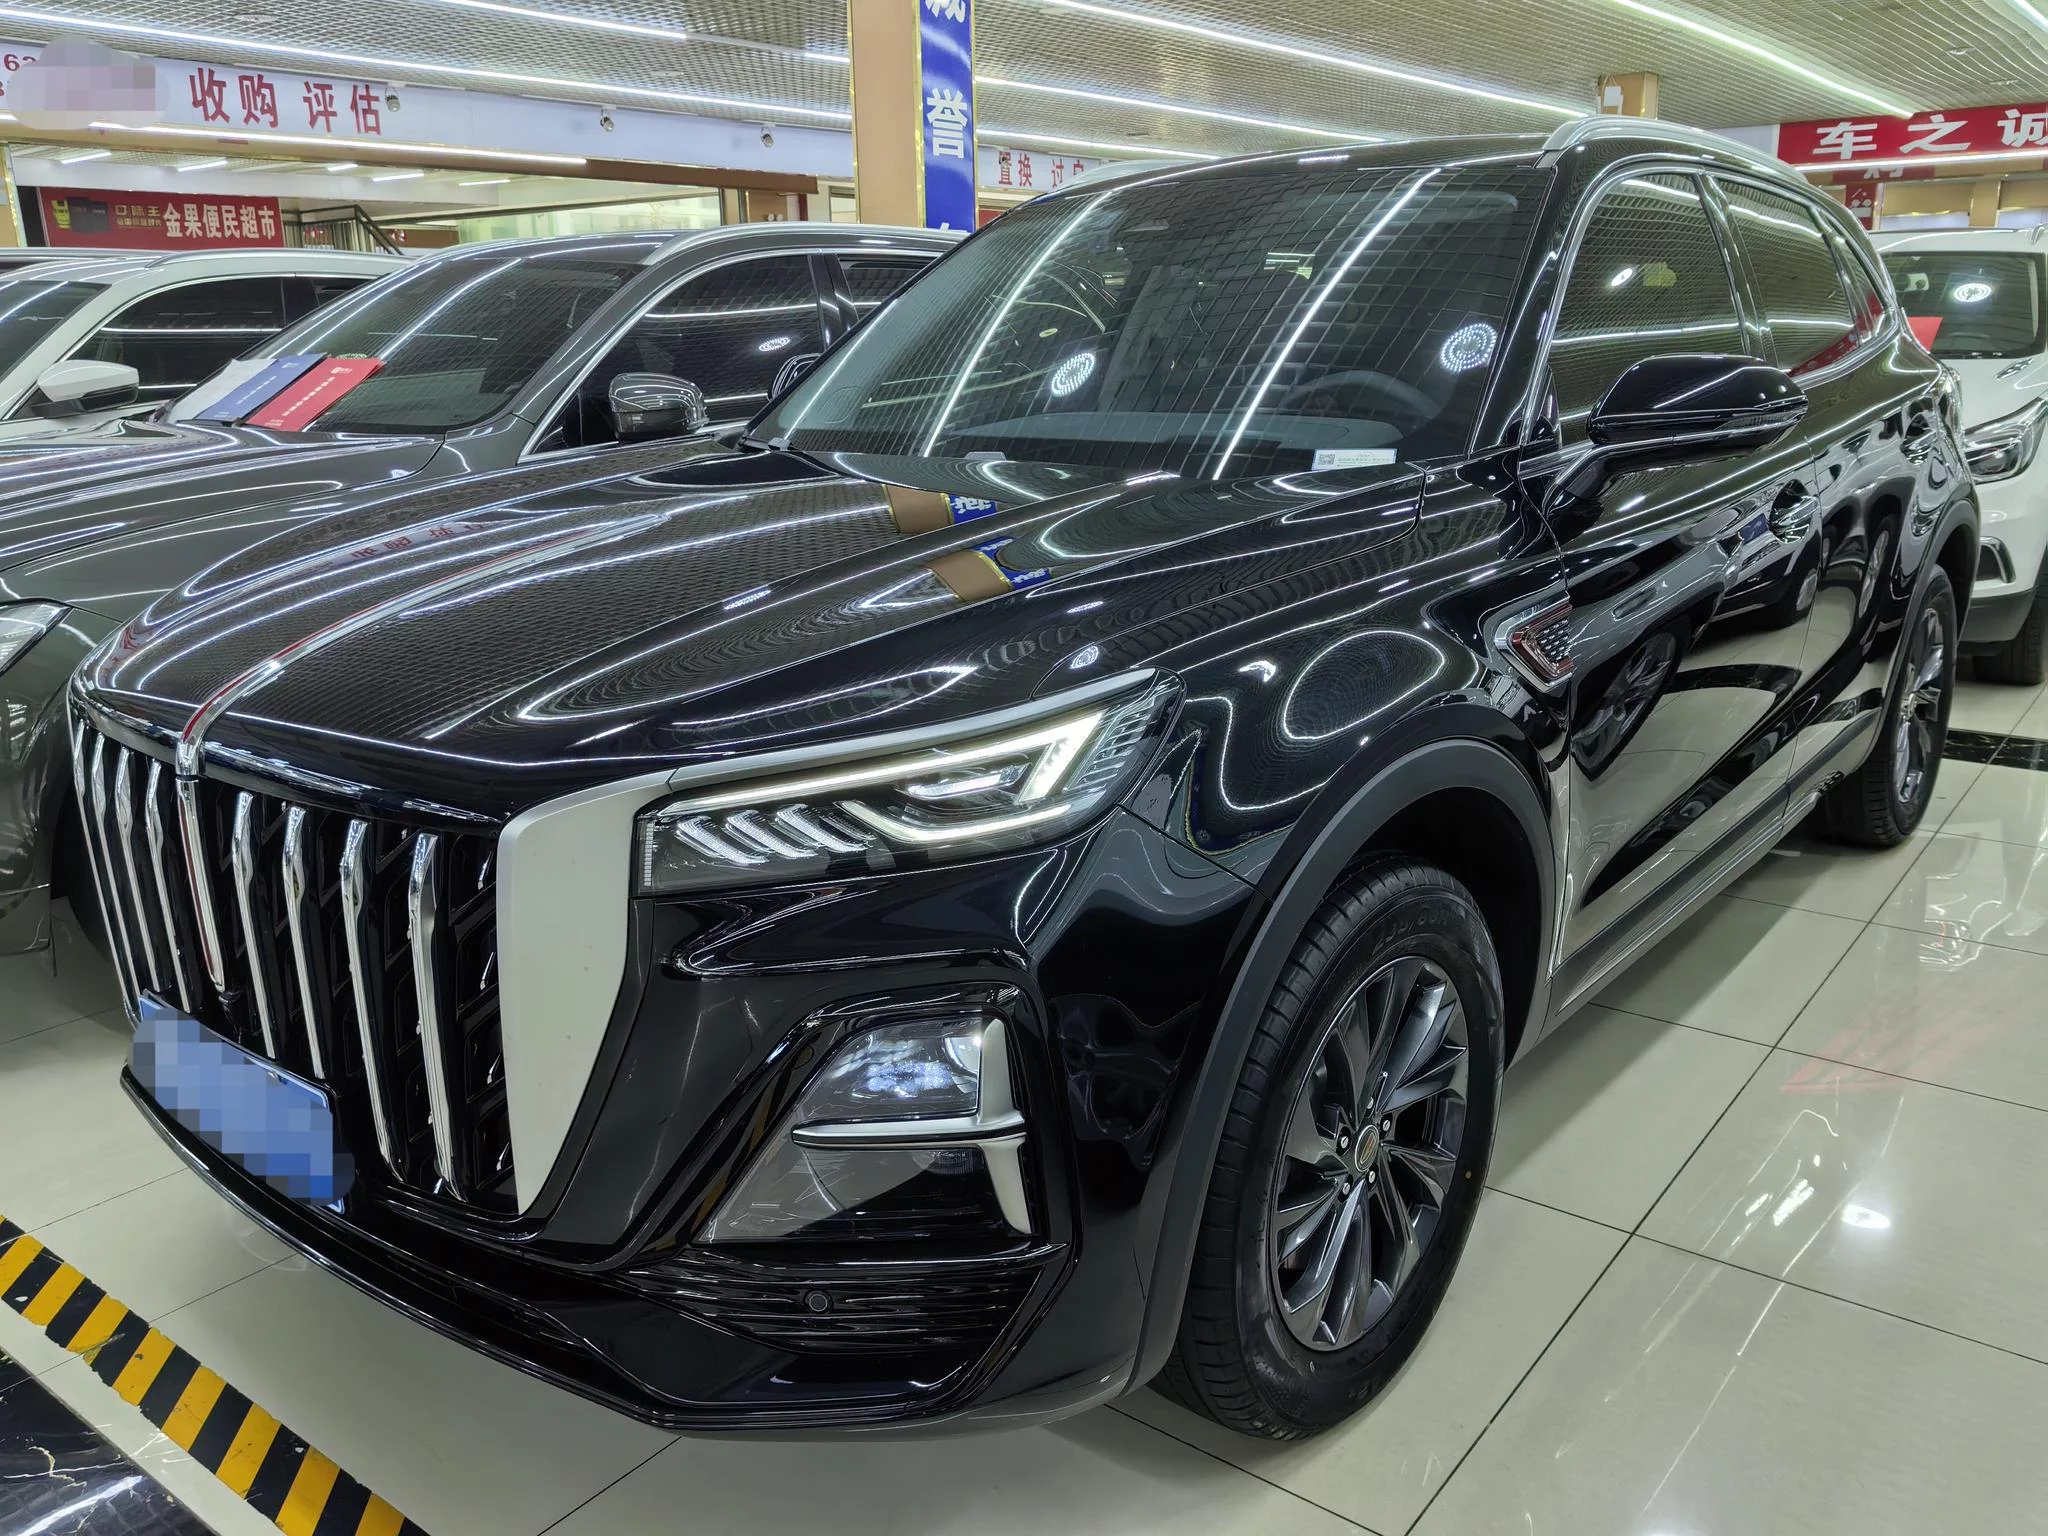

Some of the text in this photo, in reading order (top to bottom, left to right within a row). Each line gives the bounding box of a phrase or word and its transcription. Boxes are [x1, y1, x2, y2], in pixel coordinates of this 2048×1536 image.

[189, 67, 381, 135] 收购 评估
[999, 152, 1032, 186] 置换
[164, 202, 276, 240] 金果便民超市
